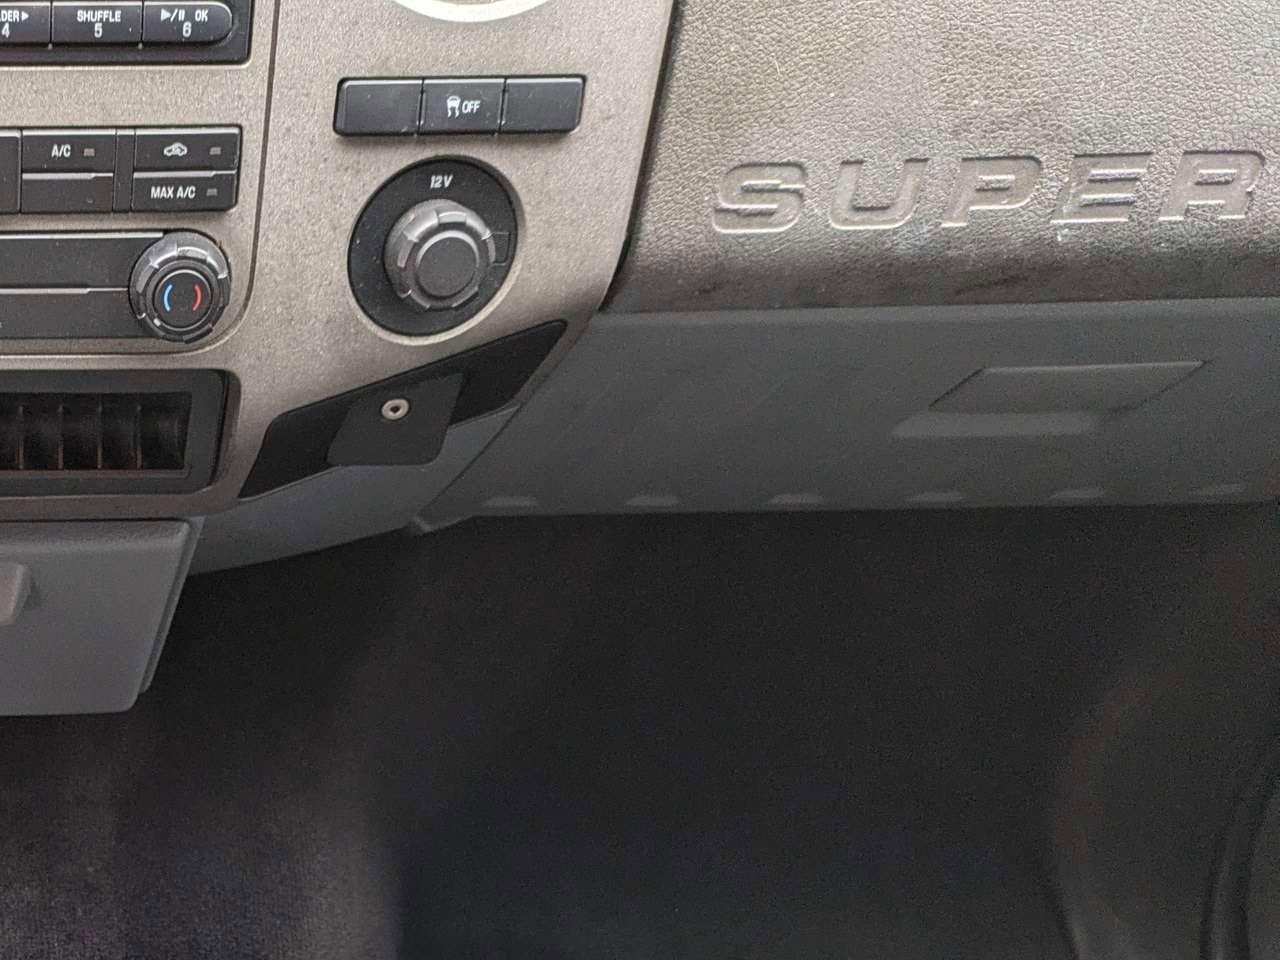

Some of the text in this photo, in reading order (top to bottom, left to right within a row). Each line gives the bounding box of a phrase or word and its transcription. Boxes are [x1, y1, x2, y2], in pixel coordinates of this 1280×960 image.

[76, 9, 122, 23] SHUFFLE
[194, 9, 209, 22] OK
[1, 23, 11, 38] 4
[94, 23, 103, 38] 5
[182, 22, 192, 38] 6
[461, 100, 481, 115] OFF
[51, 143, 71, 159] A/C
[429, 173, 454, 188] 12V
[150, 185, 196, 200] MAX A/C
[710, 149, 1266, 234] SUPER
